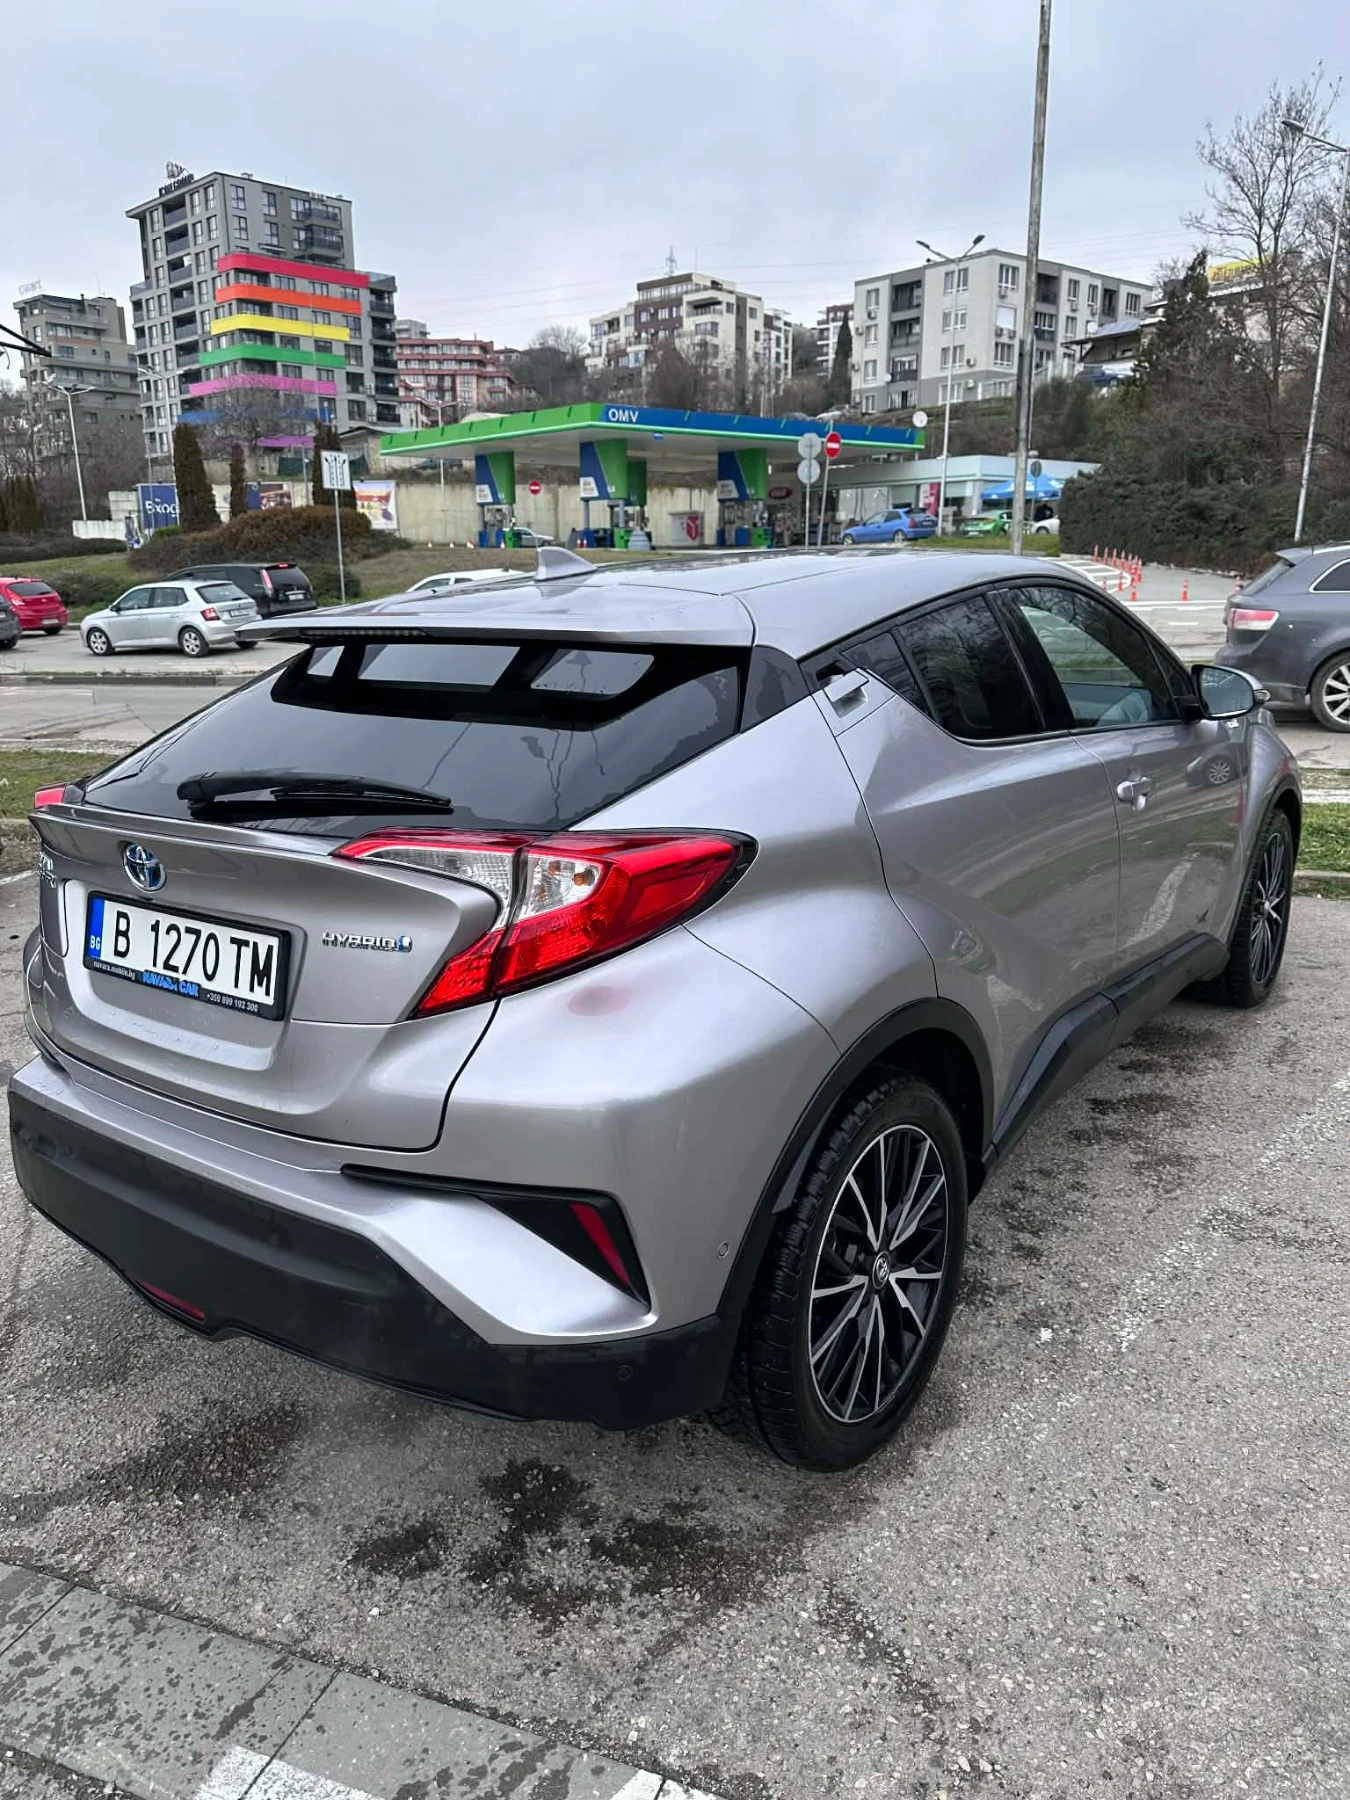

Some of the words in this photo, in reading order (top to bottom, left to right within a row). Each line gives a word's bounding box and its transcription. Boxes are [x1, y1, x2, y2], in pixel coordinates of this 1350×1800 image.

[608, 409, 639, 422] OMV
[90, 935, 101, 950] BG
[322, 930, 397, 951] HYBRID
[113, 909, 131, 958] B
[150, 919, 220, 982] 1270
[229, 936, 274, 997] TM
[93, 961, 136, 981] navara.mobile.bg
[143, 971, 178, 991] NAVARA
[179, 981, 199, 998] CAR
[207, 992, 220, 1003] +359
[234, 999, 246, 1010] 192
[246, 1002, 259, 1013] 300
